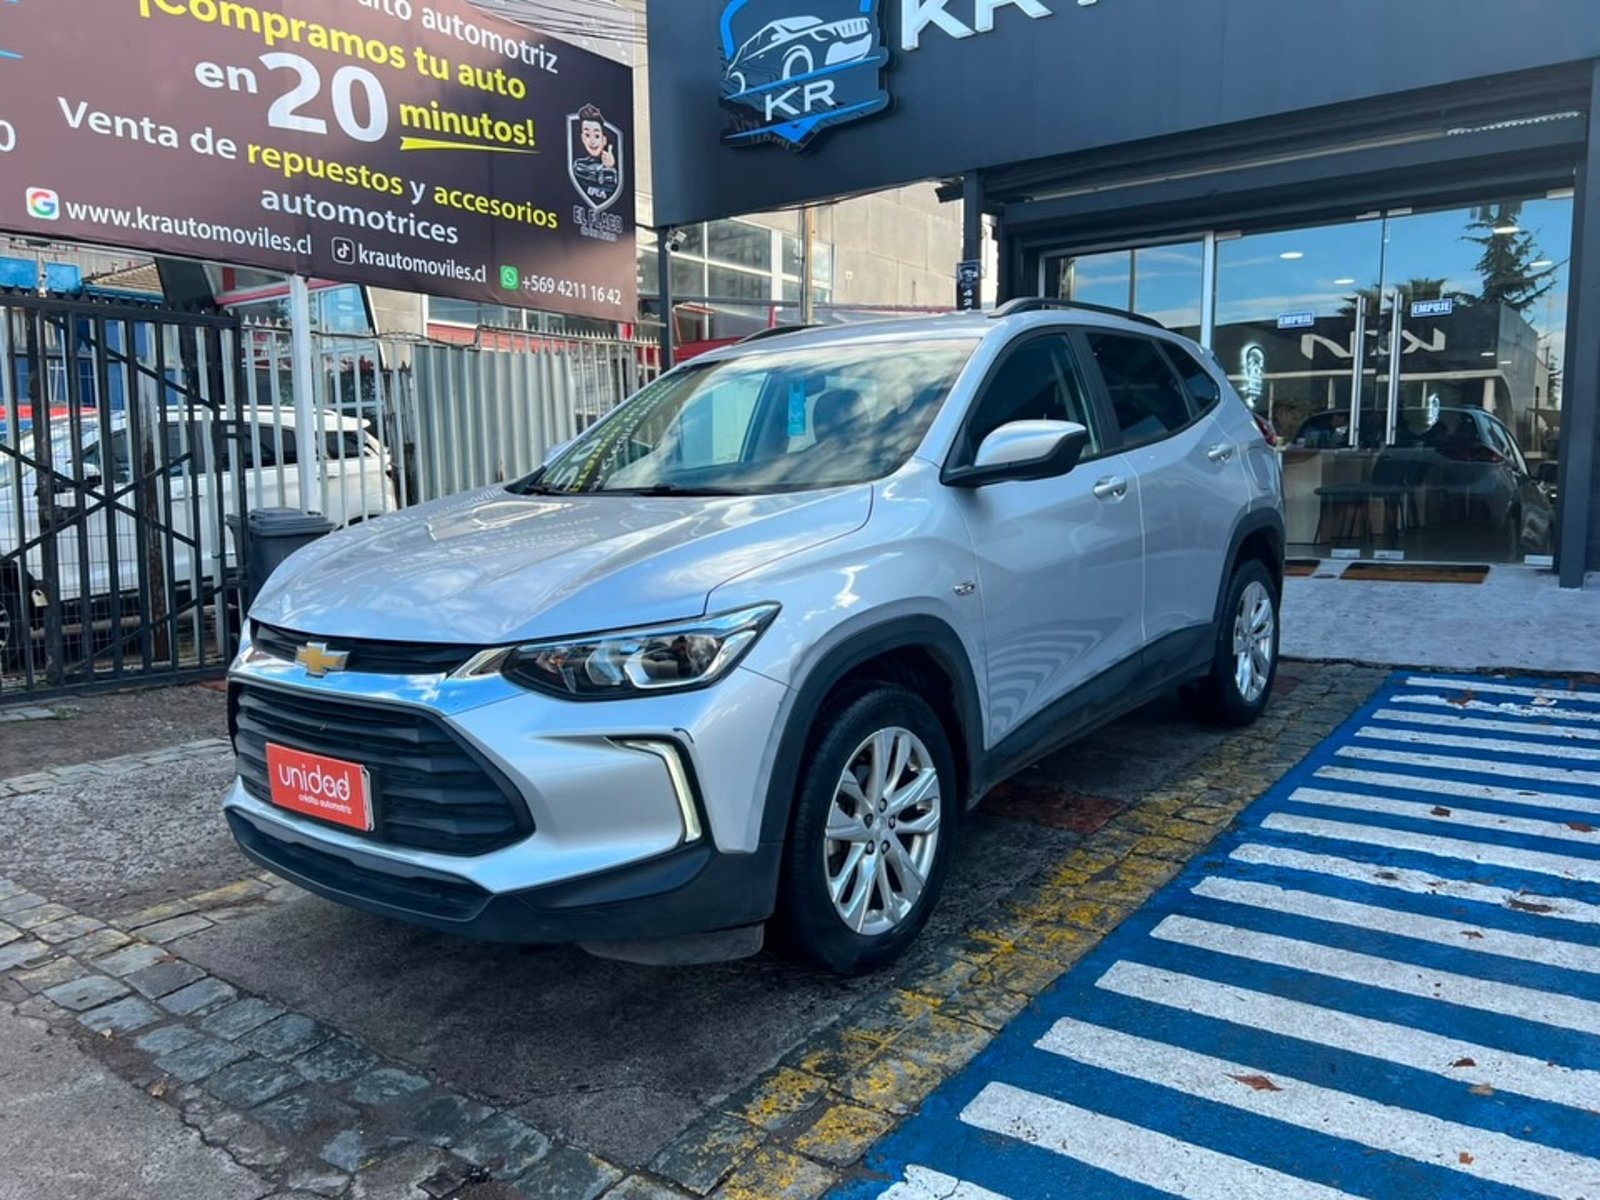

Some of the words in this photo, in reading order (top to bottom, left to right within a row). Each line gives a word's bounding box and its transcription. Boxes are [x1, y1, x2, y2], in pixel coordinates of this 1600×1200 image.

[422, 7, 559, 74] automotriz
[194, 61, 258, 95] en
[258, 51, 389, 143] 20
[400, 101, 536, 147] minutos!
[413, 46, 450, 81] tu
[458, 63, 527, 100] auto
[765, 79, 836, 122] KR
[57, 96, 180, 149] Venta
[190, 126, 237, 160] de
[247, 143, 404, 195] repuestos
[410, 180, 426, 204] y
[433, 183, 559, 230] accesorios
[66, 201, 313, 256] www.krautomoviles.cl
[261, 190, 459, 245] automotrices
[358, 244, 487, 284] krautomoviles.cl
[522, 274, 556, 294] +569
[557, 279, 586, 300] 4211
[278, 763, 351, 802] unidad
